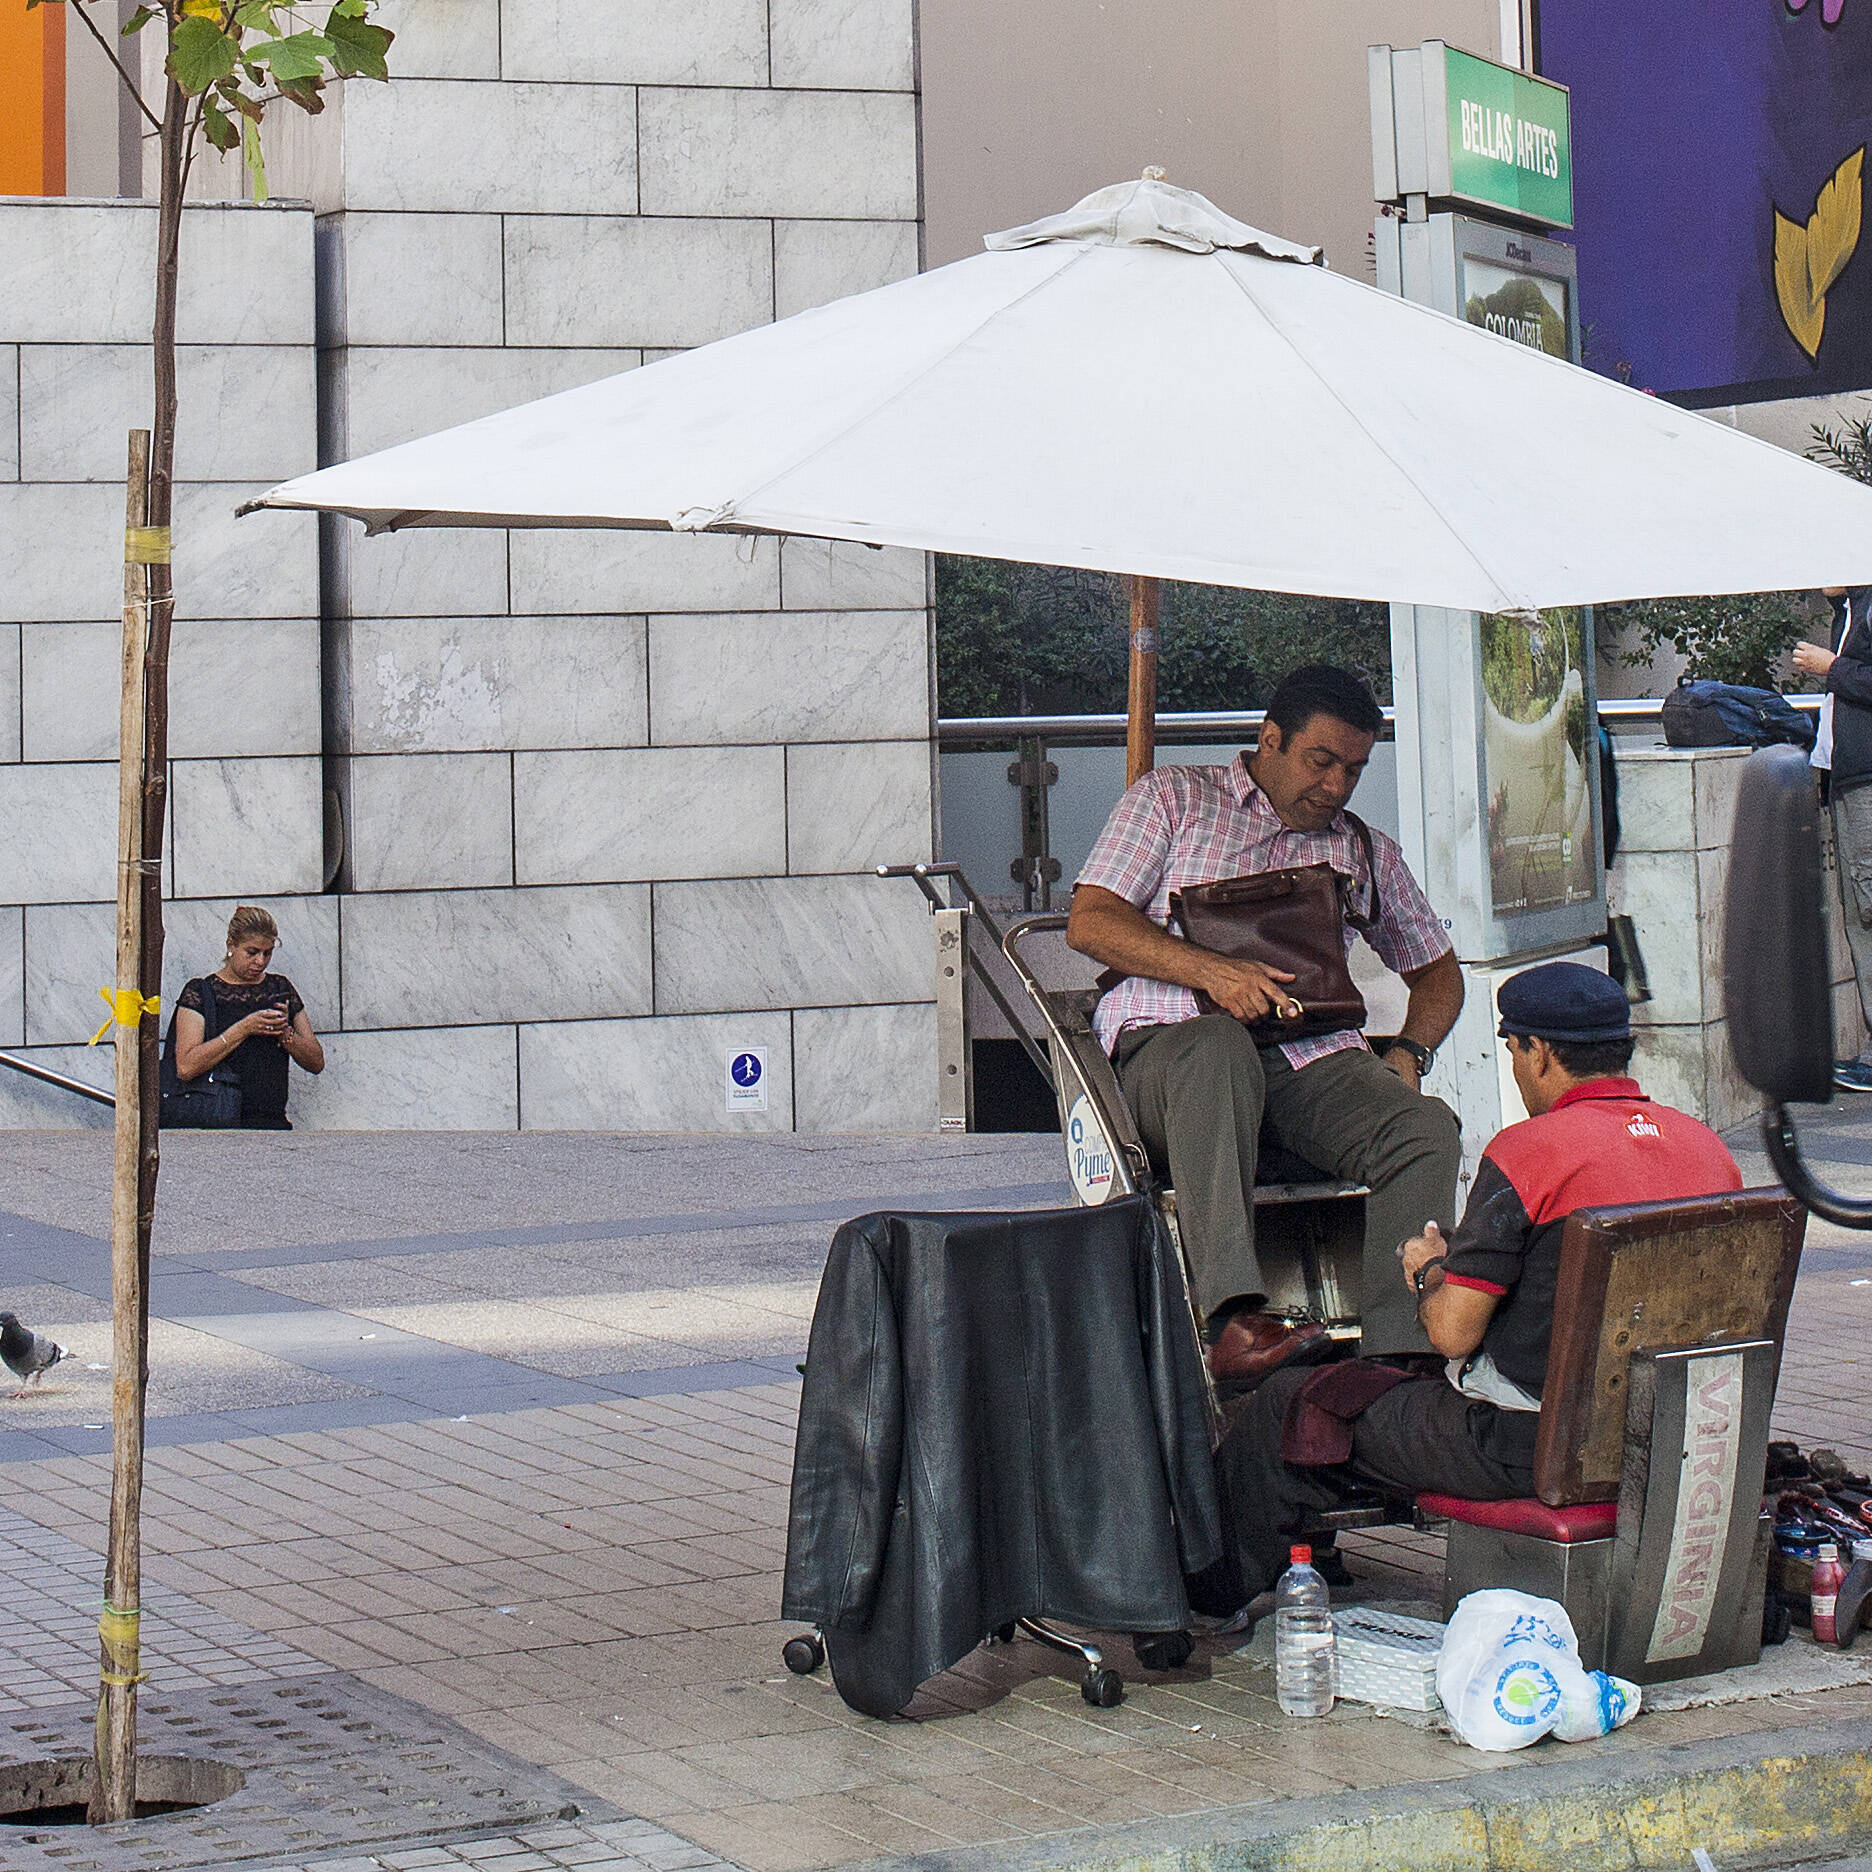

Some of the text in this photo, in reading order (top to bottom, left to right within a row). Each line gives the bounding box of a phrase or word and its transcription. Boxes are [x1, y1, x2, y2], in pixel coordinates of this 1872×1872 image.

[1460, 98, 1558, 180] BELLAS ARTES
[1626, 1122, 1660, 1137] KIWI
[1074, 1147, 1111, 1187] Pyme
[1661, 1368, 1734, 1647] VIRGINIA
